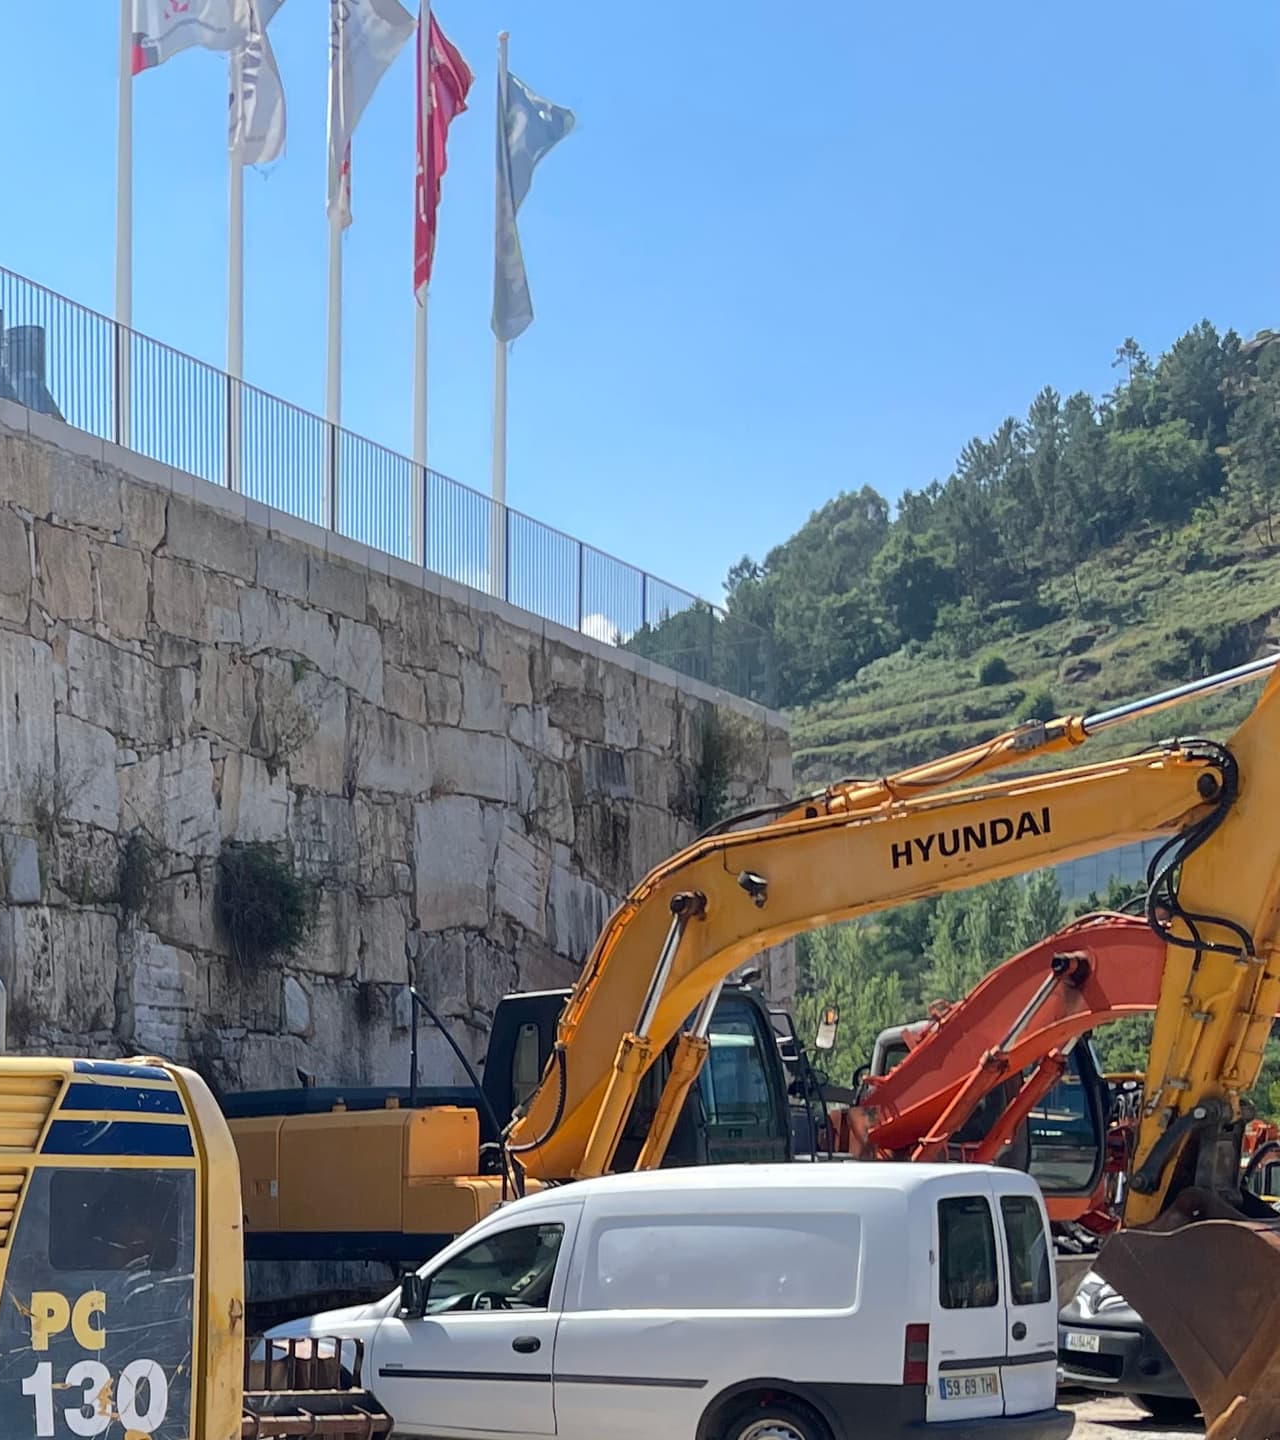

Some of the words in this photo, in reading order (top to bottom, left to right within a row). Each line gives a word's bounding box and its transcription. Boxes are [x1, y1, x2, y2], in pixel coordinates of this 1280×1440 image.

[891, 806, 1052, 869] HYUNDAI
[30, 1290, 107, 1351] PC
[21, 1357, 169, 1437] 130
[946, 1379, 961, 1396] 59
[964, 1378, 977, 1395] 69
[980, 1376, 993, 1393] TH
